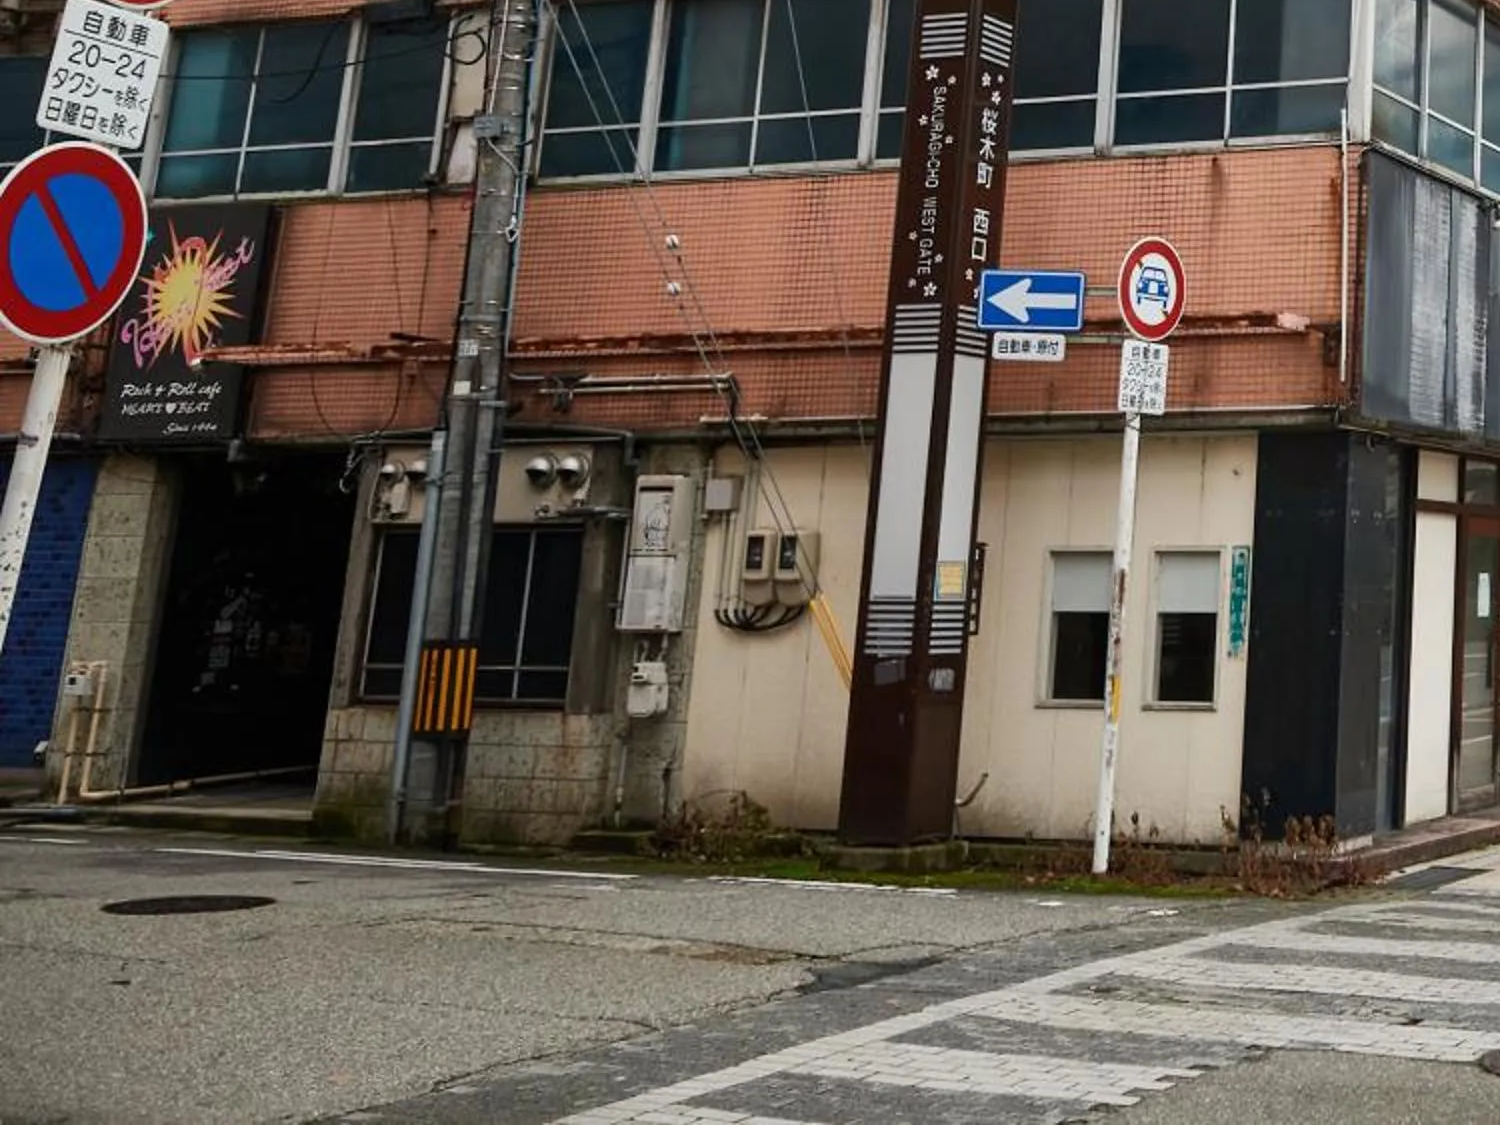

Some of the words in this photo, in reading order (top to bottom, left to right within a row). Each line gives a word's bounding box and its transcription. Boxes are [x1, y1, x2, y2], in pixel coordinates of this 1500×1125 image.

[83, 10, 152, 47] 自動車
[67, 40, 147, 79] 20-24
[51, 67, 149, 112] タクシーを除く
[45, 96, 140, 140] 日曜日を除く
[976, 106, 1000, 191] 桜木町
[920, 197, 938, 235] WEST
[971, 208, 991, 263] 西口
[917, 238, 934, 276] GATE
[167, 382, 197, 397] Roll
